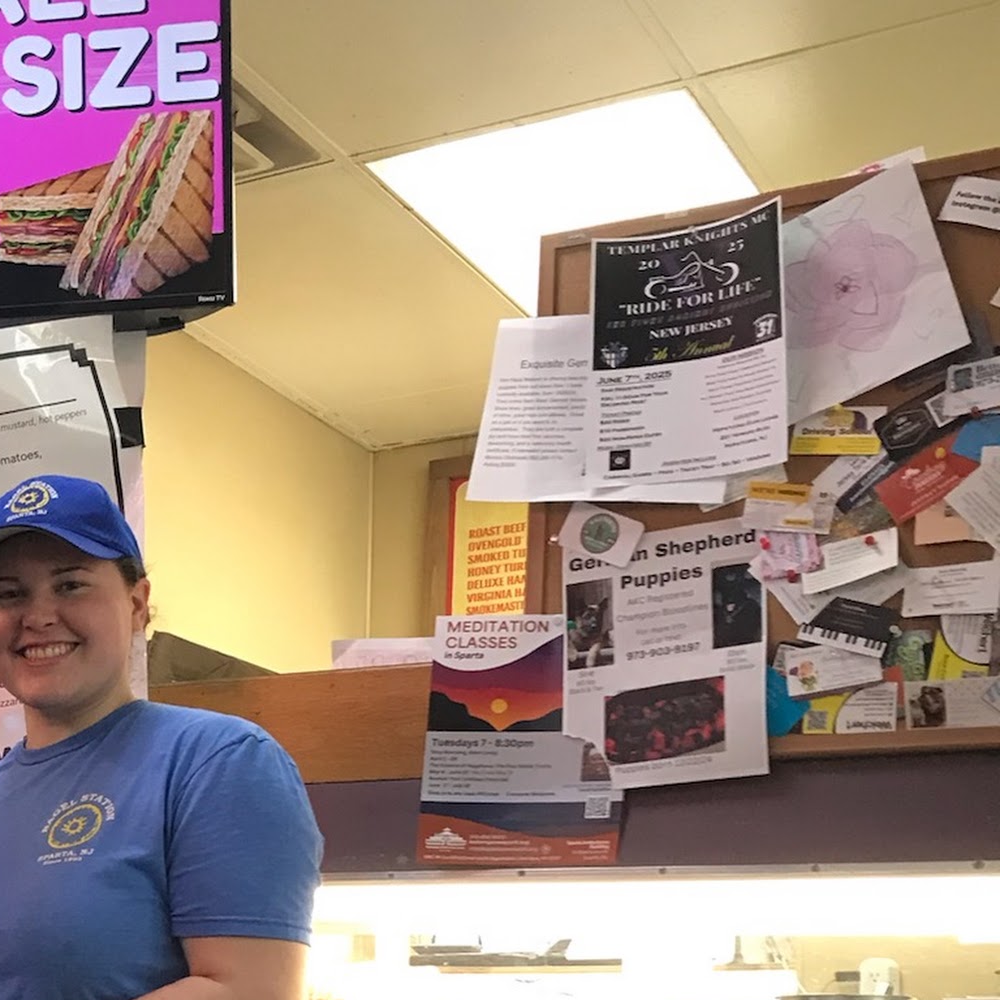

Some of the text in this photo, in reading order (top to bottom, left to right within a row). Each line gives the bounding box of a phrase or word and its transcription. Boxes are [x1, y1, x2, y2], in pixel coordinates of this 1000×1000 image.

[2, 21, 221, 116] SIZE
[607, 210, 770, 256] TEMPLAR KNIGHTS MC
[727, 239, 745, 253] 25
[638, 259, 660, 271] 20
[677, 293, 713, 309] FOR
[650, 316, 733, 340] NEW JERSEY
[645, 371, 672, 380] 2025
[0, 418, 38, 433] mustard,
[54, 408, 88, 424] peppers
[469, 522, 527, 539] ROAST BEEF
[468, 535, 522, 551] OVENGOLD
[655, 528, 757, 558] Shepherd
[467, 550, 510, 565] SMOKED
[467, 565, 503, 577] HONEY
[621, 565, 703, 589] Puppies
[467, 577, 504, 590] DELUXE
[467, 589, 512, 603] VIRGINIA
[447, 620, 550, 634] MEDITATION
[446, 636, 518, 649] CLASSES
[454, 651, 485, 661] Sparta
[432, 738, 478, 750] Tuesdays
[80, 793, 116, 821] STATION
[80, 848, 95, 856] NJ
